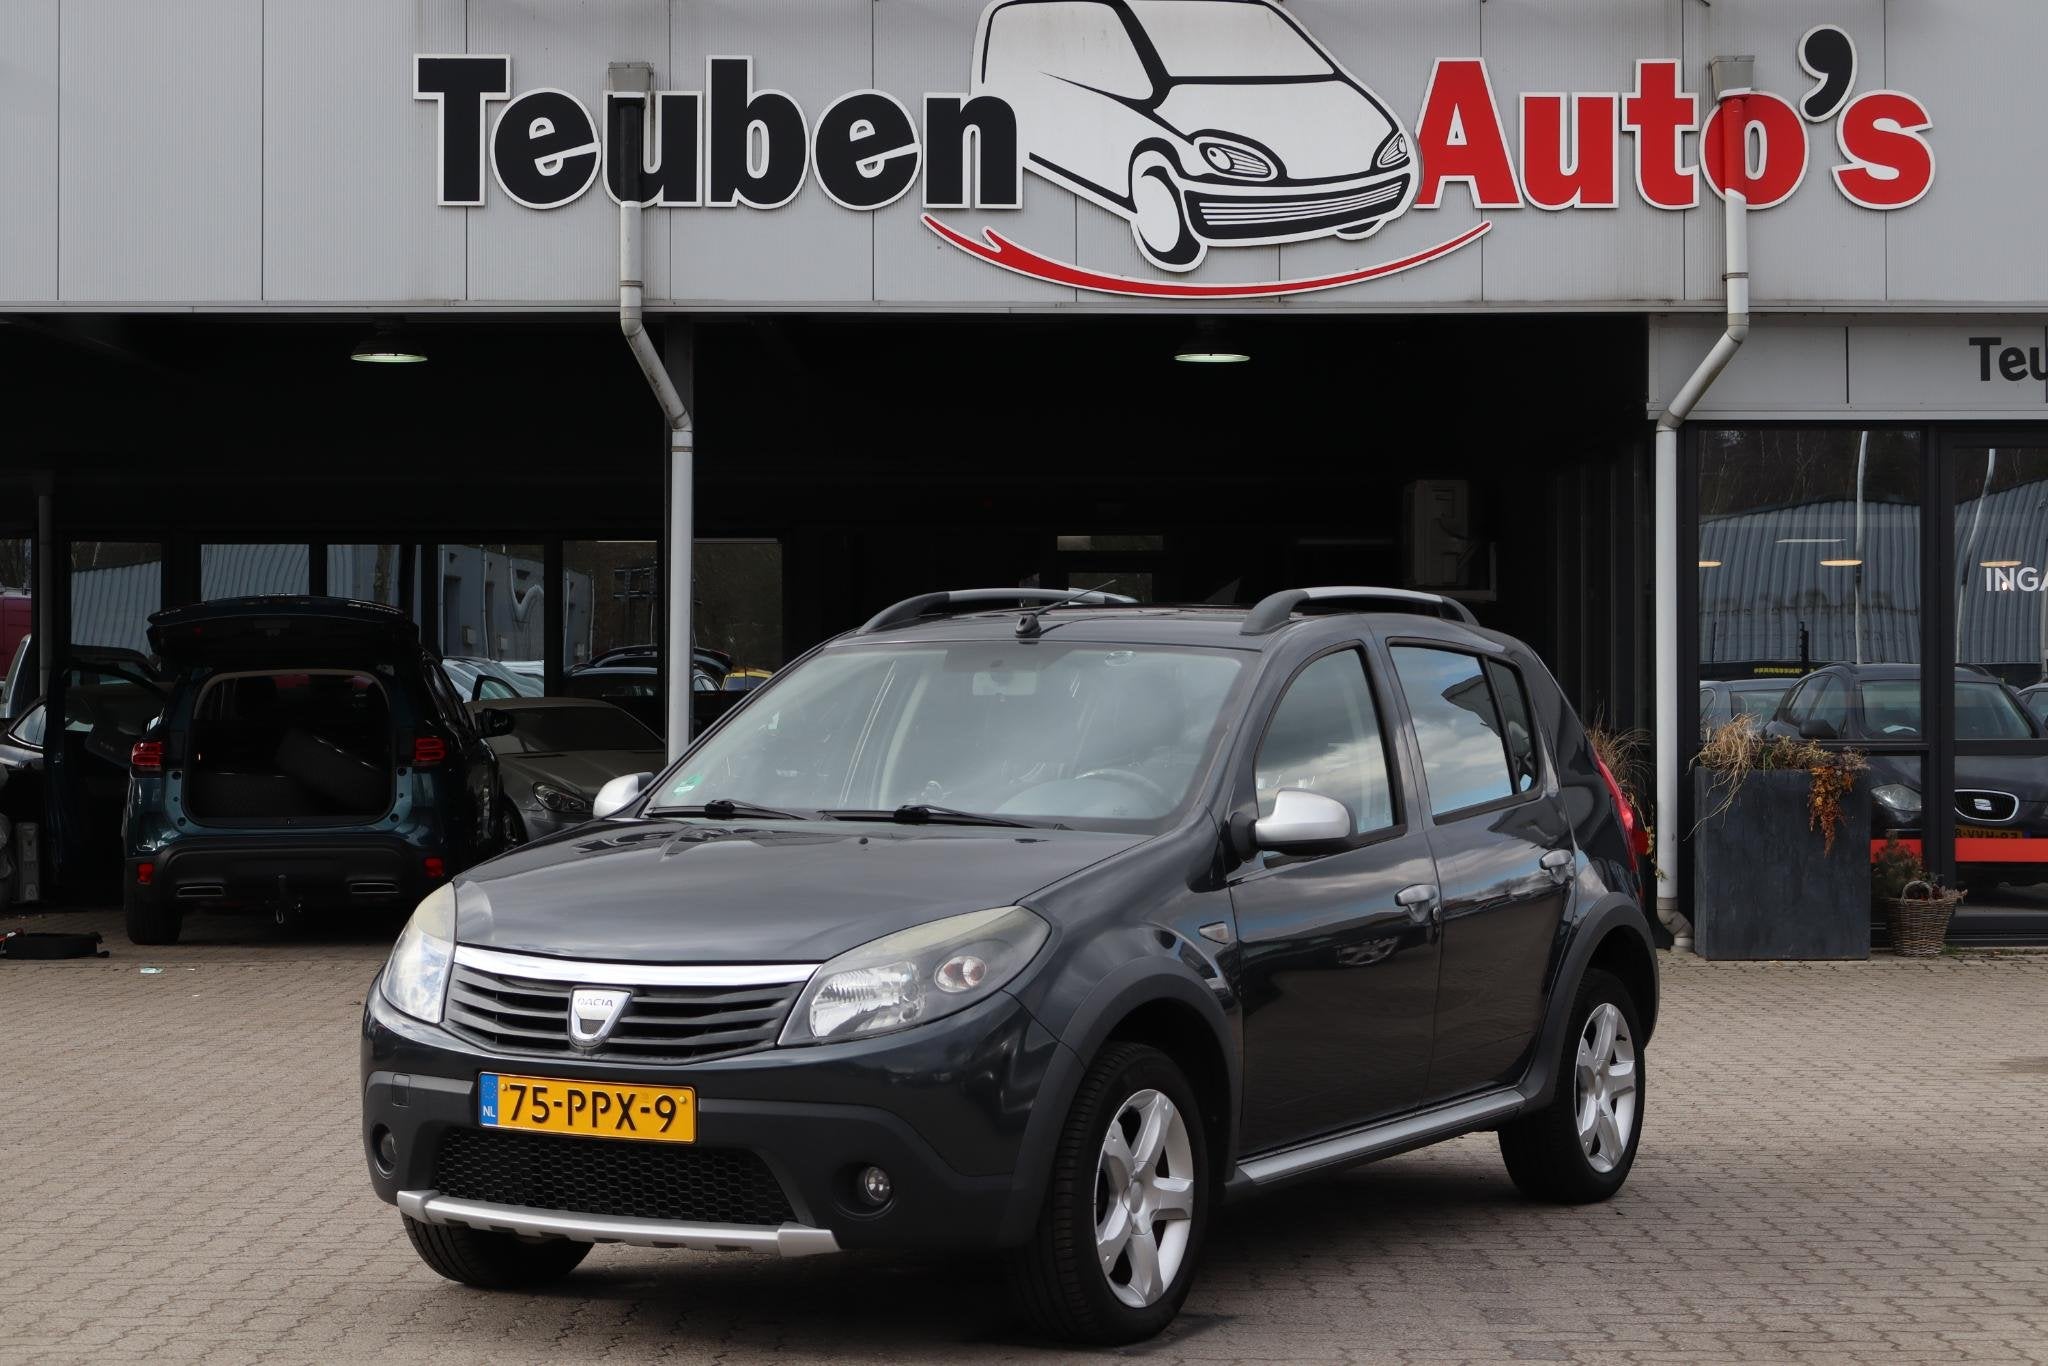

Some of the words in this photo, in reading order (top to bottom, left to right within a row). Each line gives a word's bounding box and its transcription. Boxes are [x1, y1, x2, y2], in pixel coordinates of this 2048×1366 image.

[415, 55, 1022, 209] Teuben
[1414, 25, 1937, 210] Auto's
[1968, 337, 2048, 381] Teu
[483, 1105, 496, 1118] NL
[509, 1084, 677, 1133] 75-PPX-9
